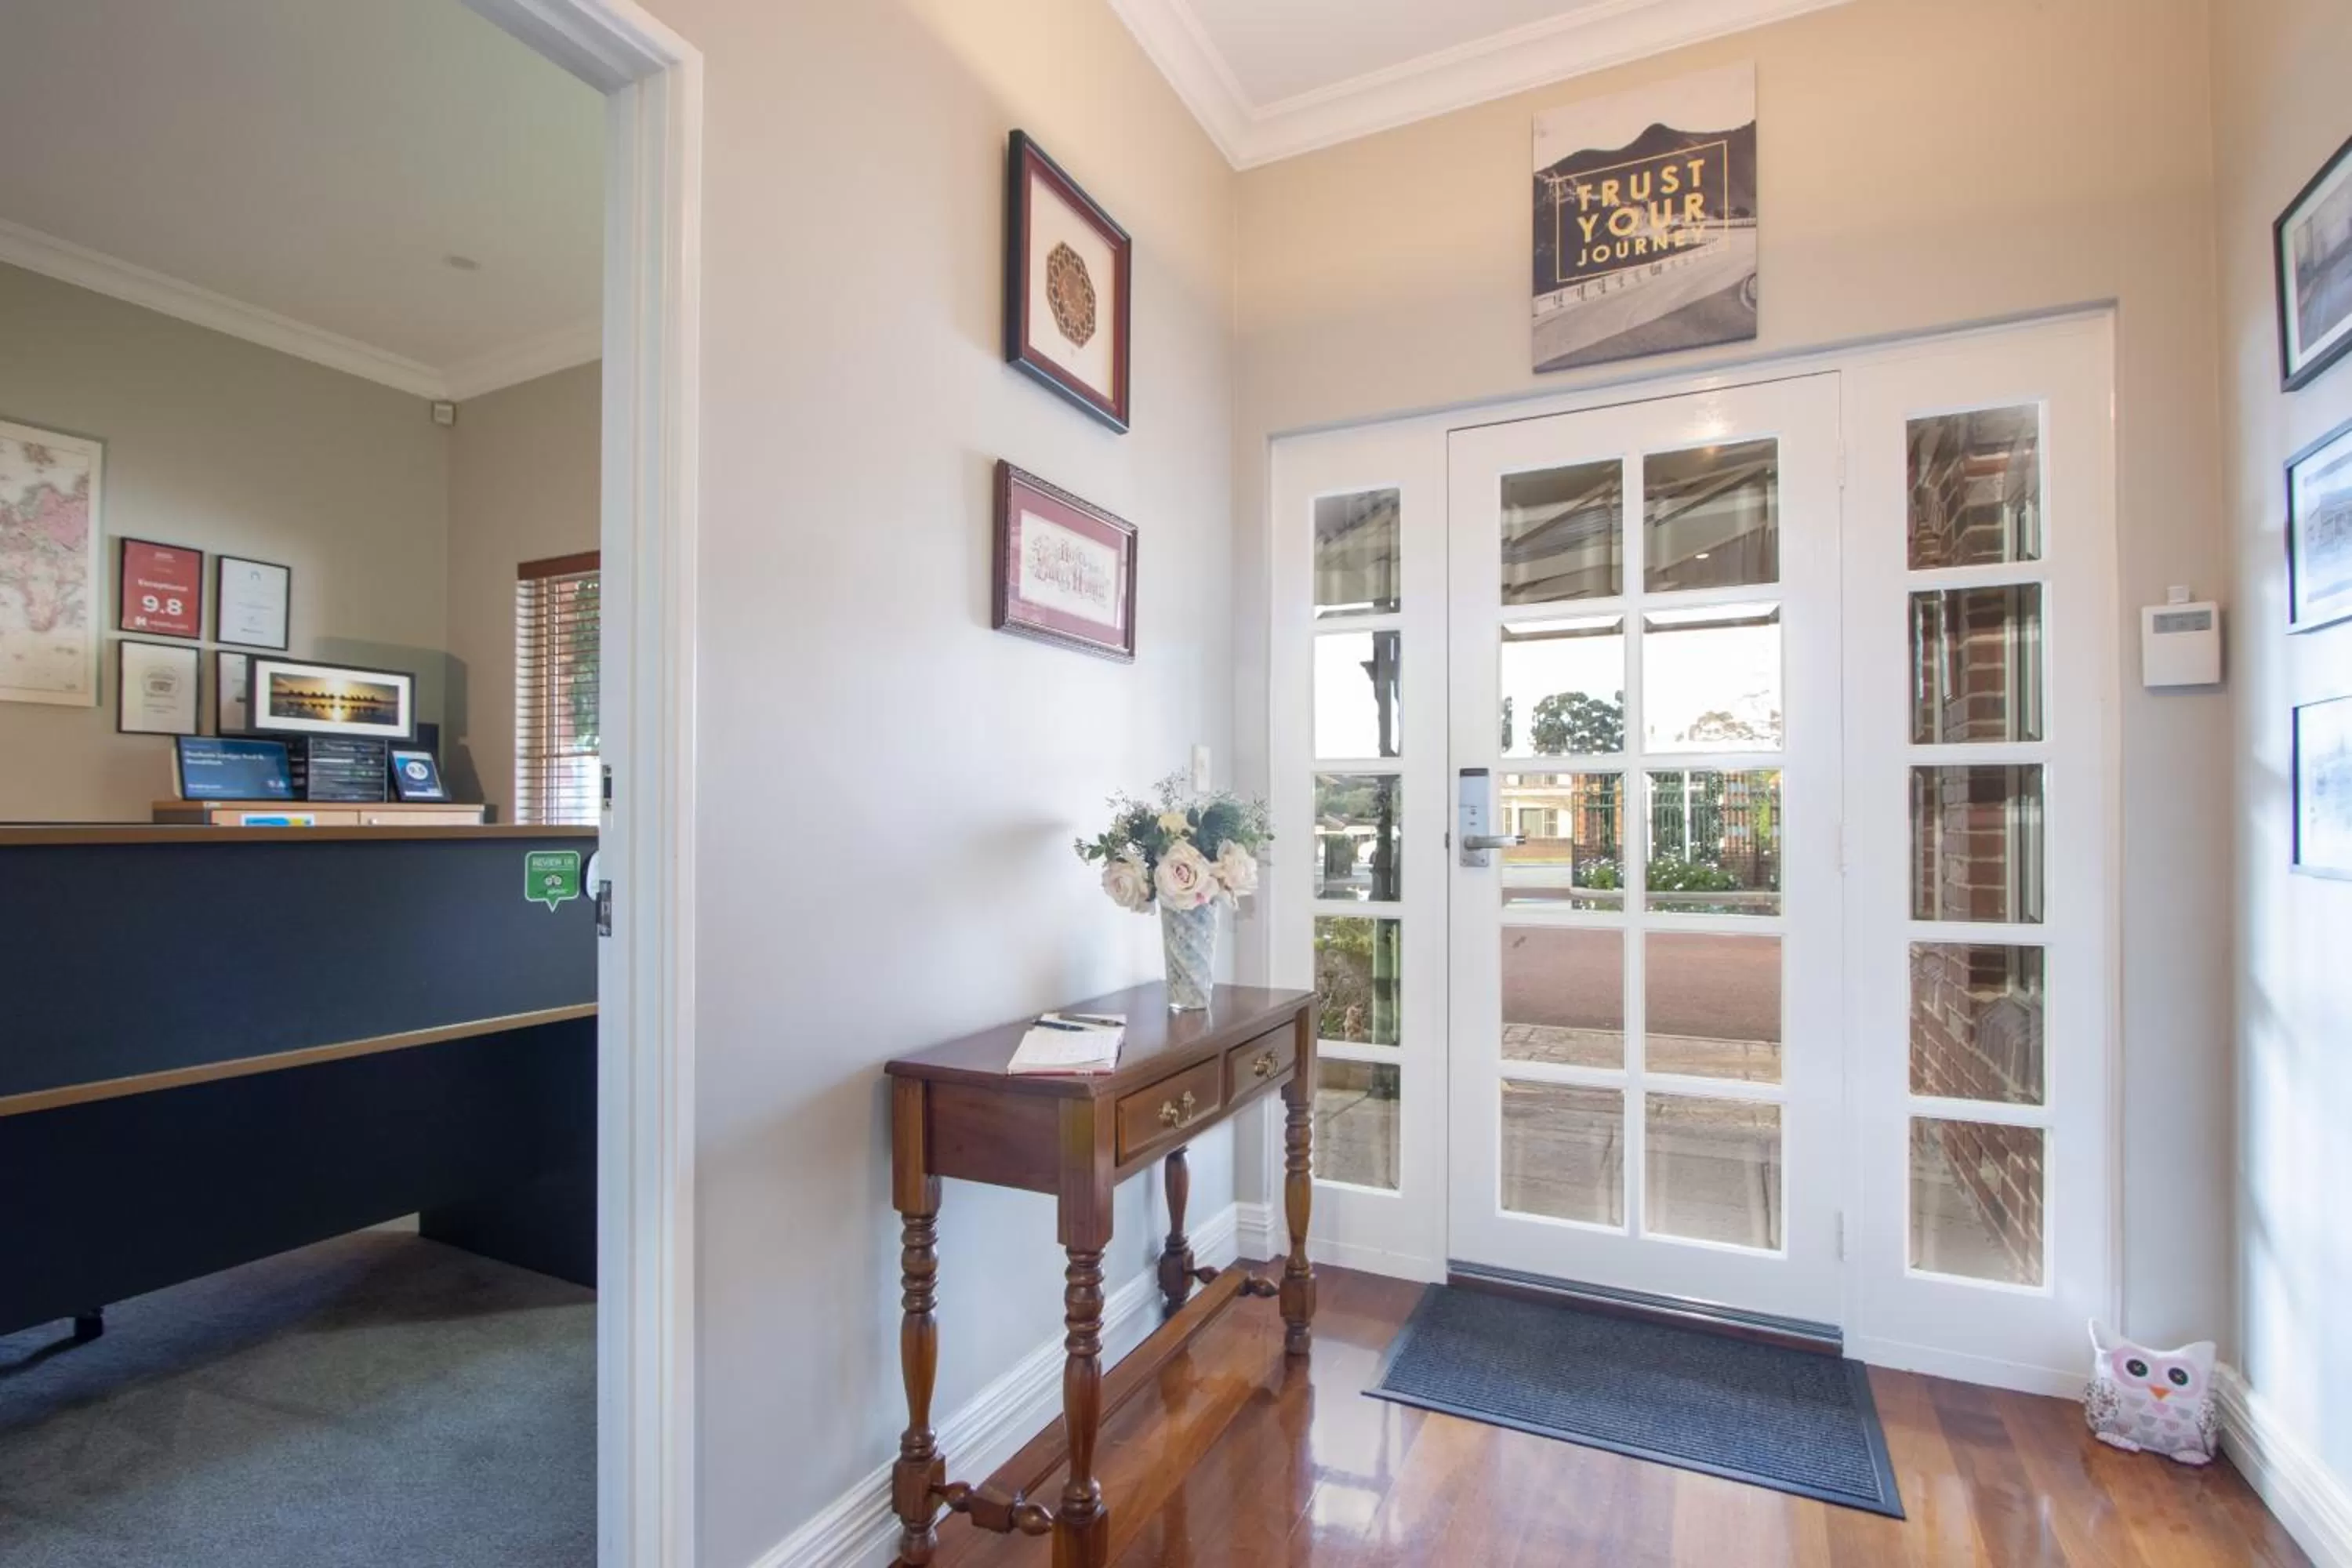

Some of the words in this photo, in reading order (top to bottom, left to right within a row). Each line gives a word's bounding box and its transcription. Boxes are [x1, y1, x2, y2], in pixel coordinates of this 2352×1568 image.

[1577, 159, 1705, 212] TRUST
[1577, 192, 1706, 243] YOUR
[1577, 224, 1704, 267] JOURNEY
[141, 594, 183, 616] 9.8
